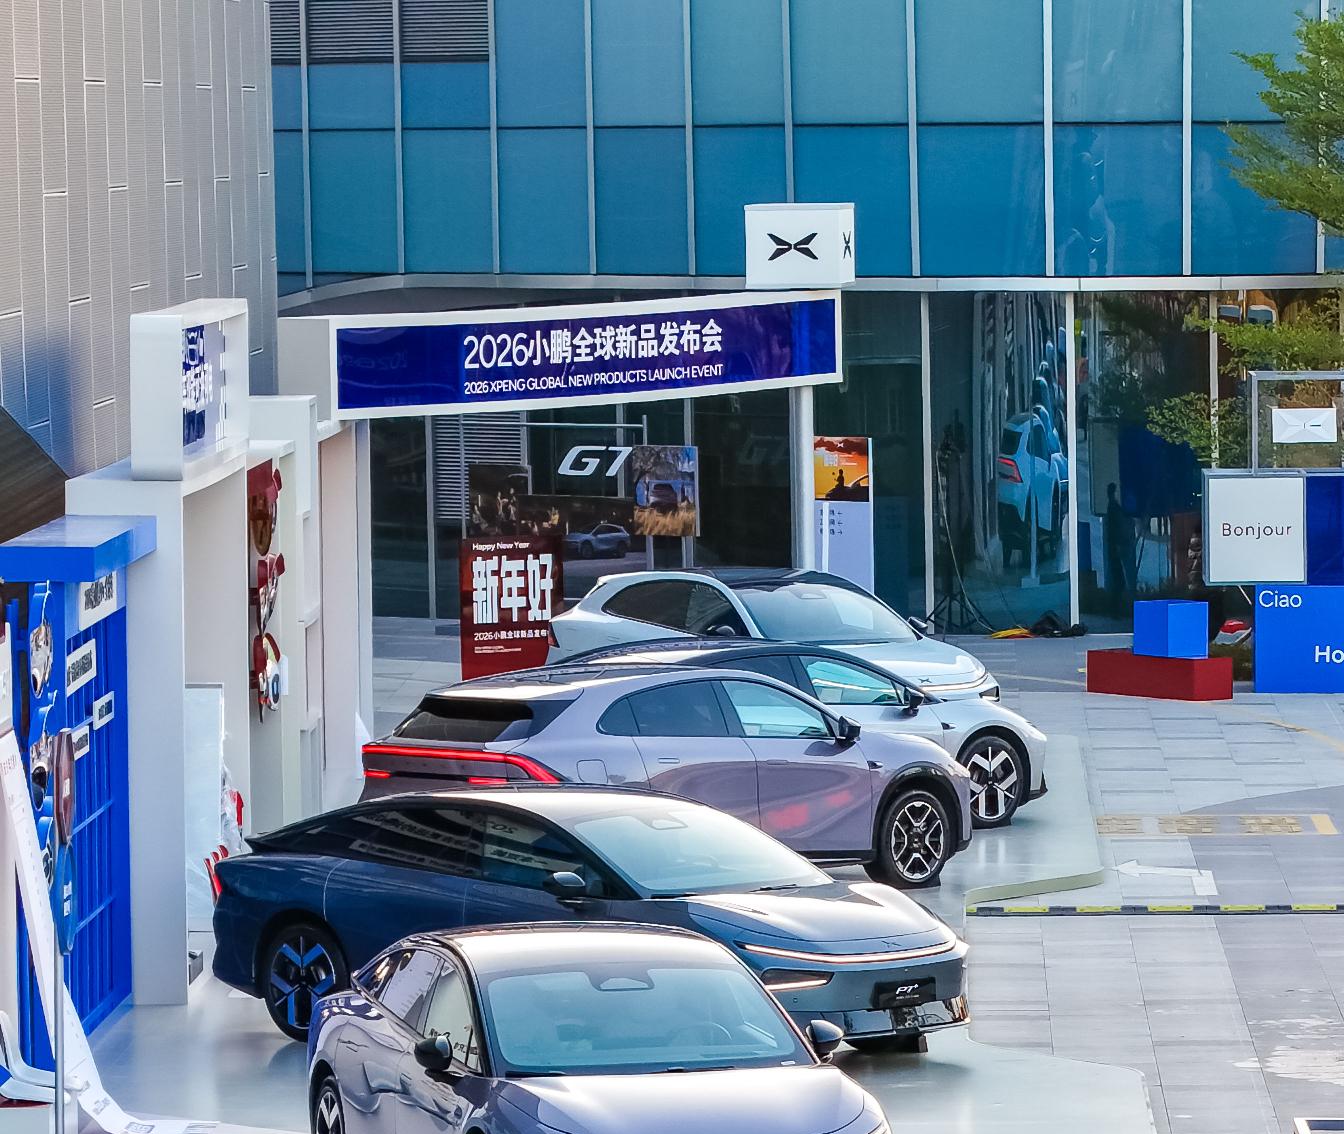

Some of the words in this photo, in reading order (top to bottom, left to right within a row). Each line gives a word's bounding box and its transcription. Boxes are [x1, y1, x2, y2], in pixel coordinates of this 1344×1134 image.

[464, 319, 722, 369] 2026小鹏全球新品发布会
[464, 381, 489, 394] 2026
[490, 378, 525, 392] XPENG
[526, 377, 567, 390] GLOBAL
[568, 374, 592, 387] NEW
[594, 369, 647, 385] PRODUCTS
[648, 366, 690, 381] LAUNCH
[692, 364, 723, 378] EVENT
[557, 445, 633, 477] G7
[1222, 522, 1292, 540] Bonjour
[472, 543, 496, 552] Happy
[496, 542, 513, 551] New
[514, 541, 530, 549] Year
[472, 553, 554, 625] 新年好
[1258, 590, 1302, 608] Ciao
